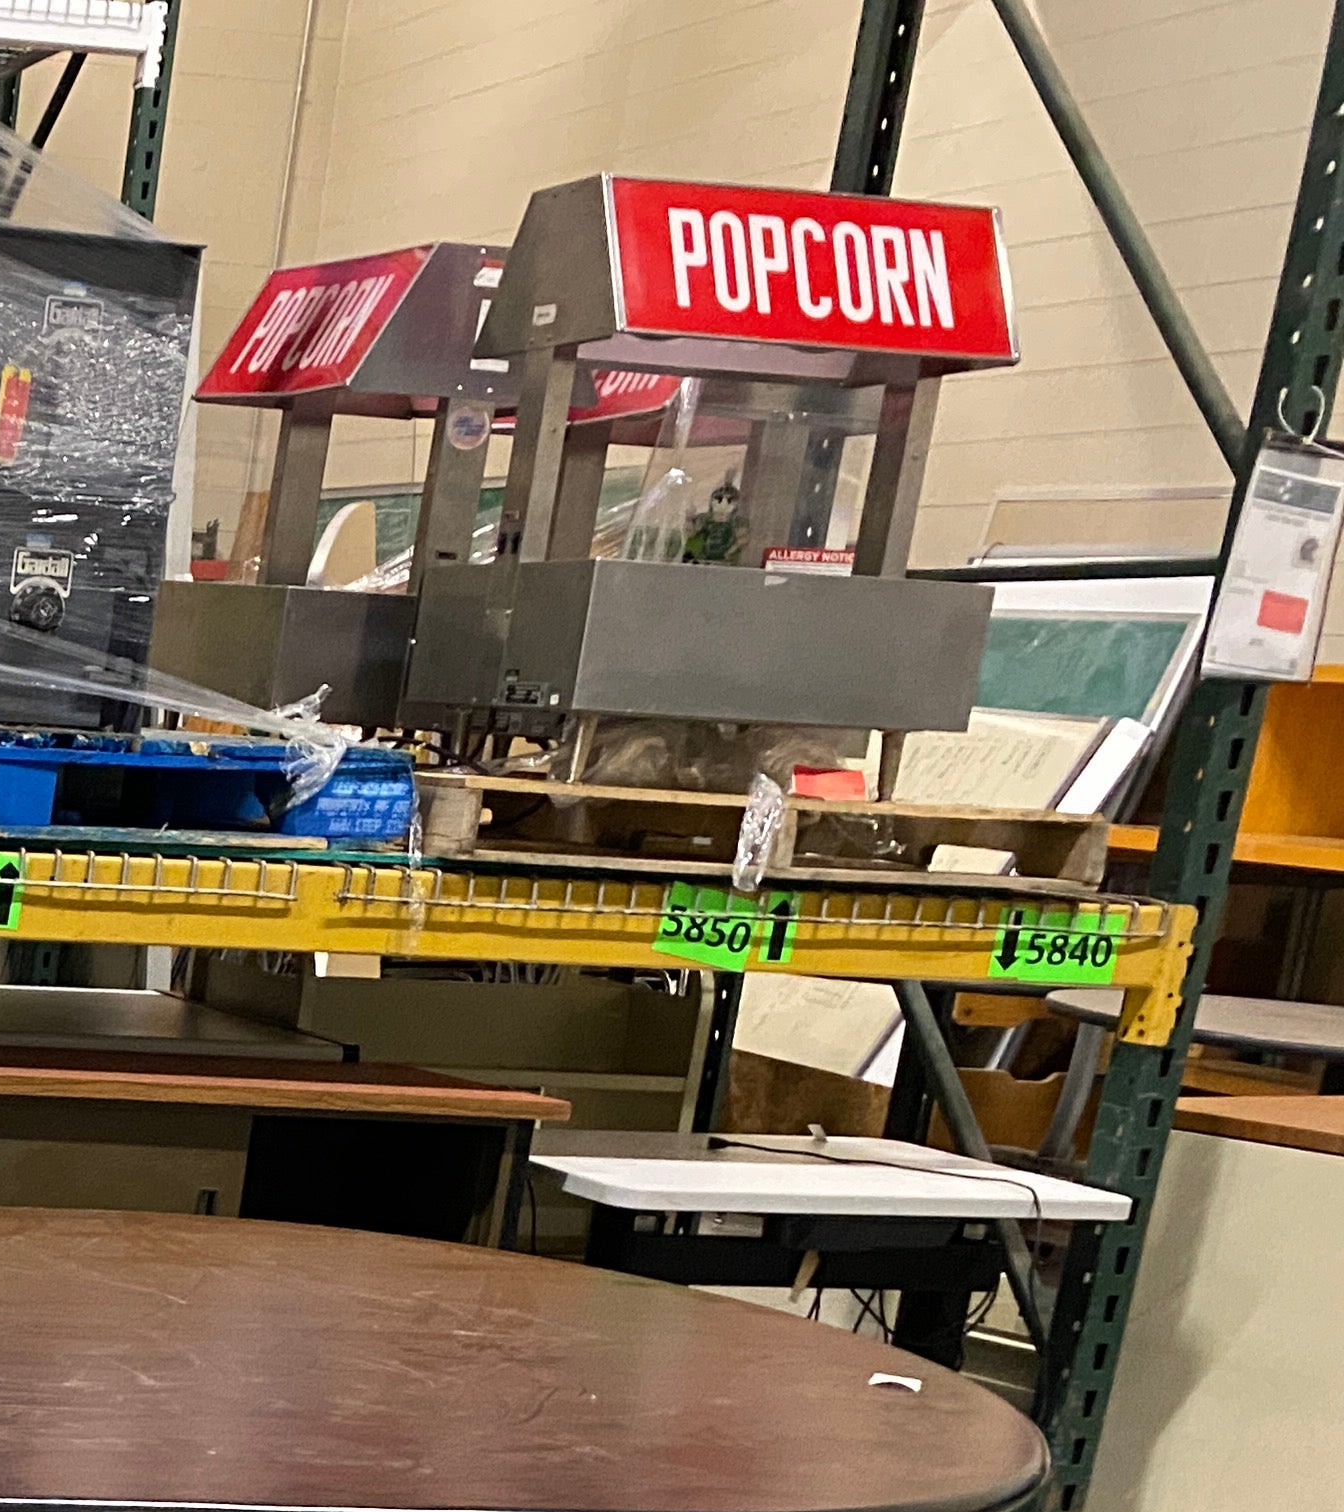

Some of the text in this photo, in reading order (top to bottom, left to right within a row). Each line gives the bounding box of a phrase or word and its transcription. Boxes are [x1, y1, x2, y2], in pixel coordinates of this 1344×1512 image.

[667, 206, 955, 330] POPCORN
[229, 273, 396, 375] POPCORN
[768, 549, 819, 561] ALLERGY
[662, 903, 752, 953] 5850
[1024, 932, 1113, 968] 5840
